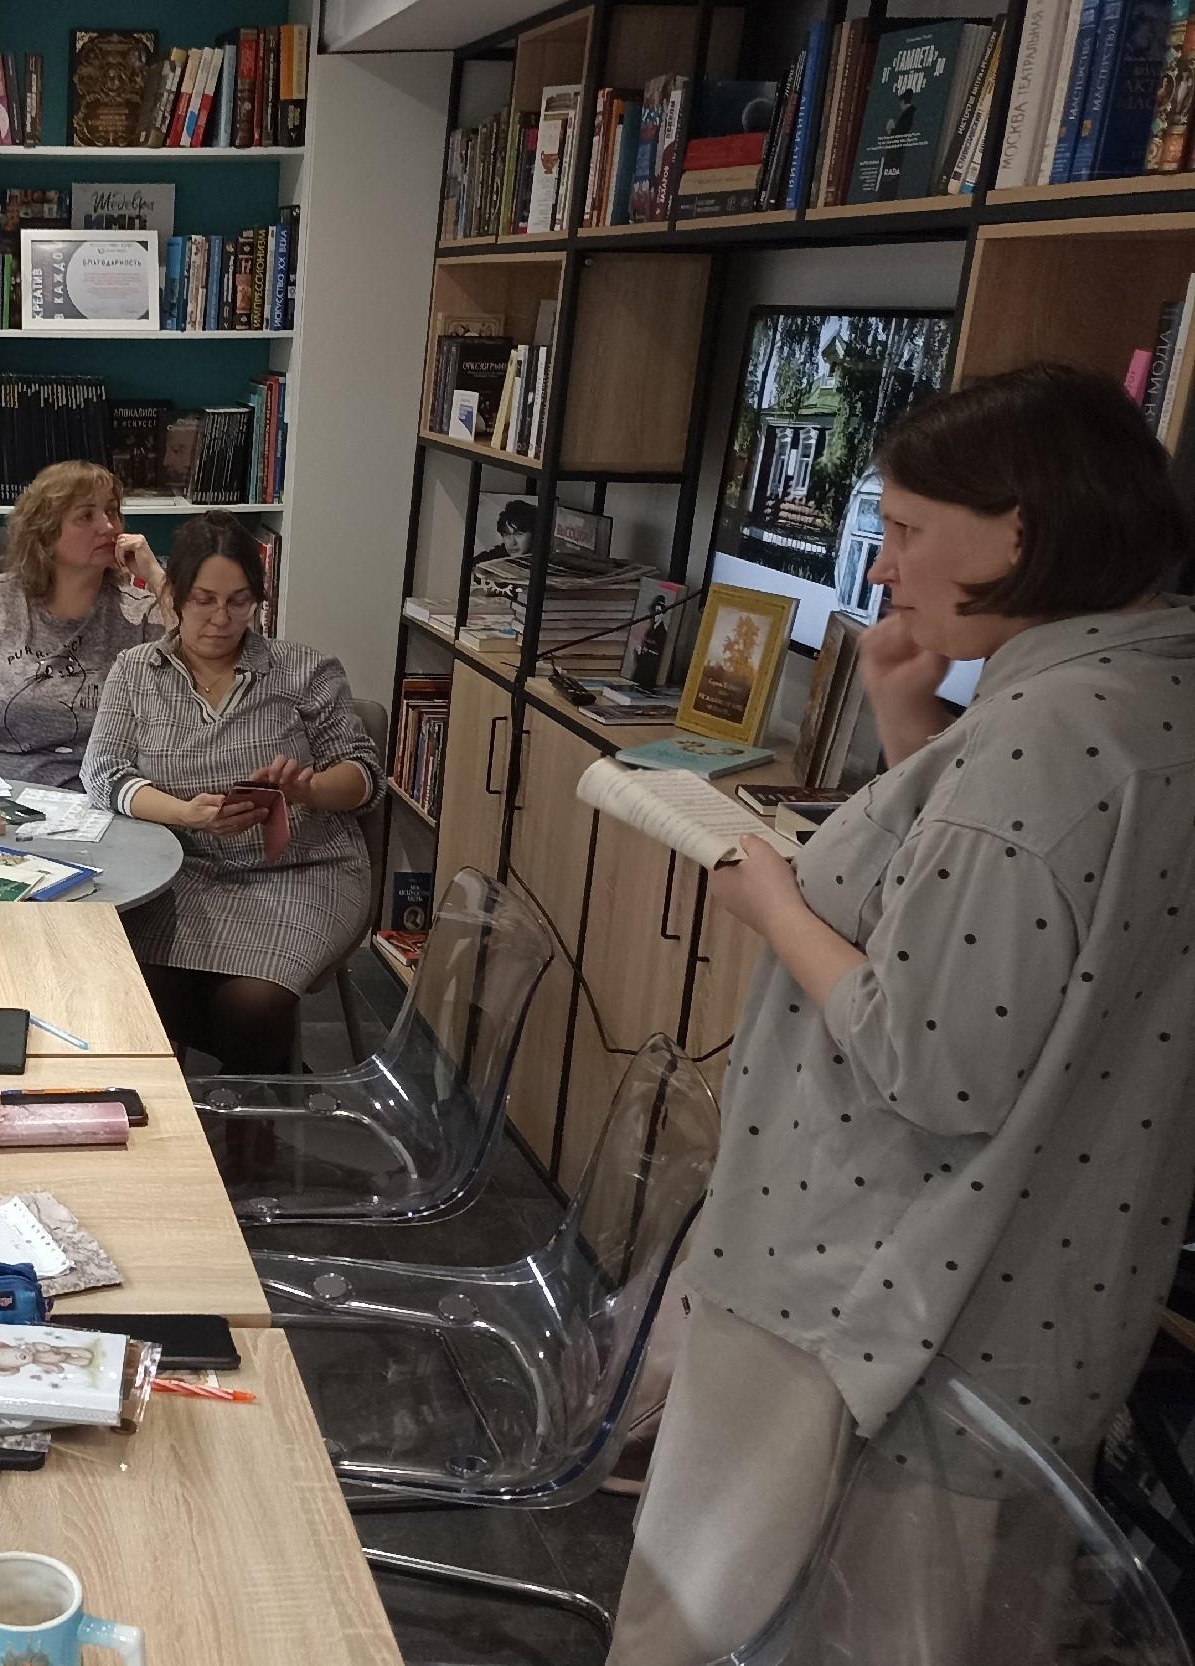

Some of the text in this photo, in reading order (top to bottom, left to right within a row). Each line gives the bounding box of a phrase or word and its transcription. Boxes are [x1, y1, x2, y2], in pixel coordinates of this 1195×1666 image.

[1002, 9, 1044, 170] МОСКВА ТЕАТРАЛЬНАЯ
[82, 259, 142, 267] БЛАГОДАРНОСТЬ
[279, 229, 287, 253] ВЕКА
[32, 268, 44, 320] КРЕАТИВ
[53, 250, 66, 304] КАЖДО
[252, 229, 266, 328] ИМПРЕССИОНИЗМ
[274, 274, 285, 327] ИСКУССТВО
[113, 407, 159, 418] АПОКАЛИПС
